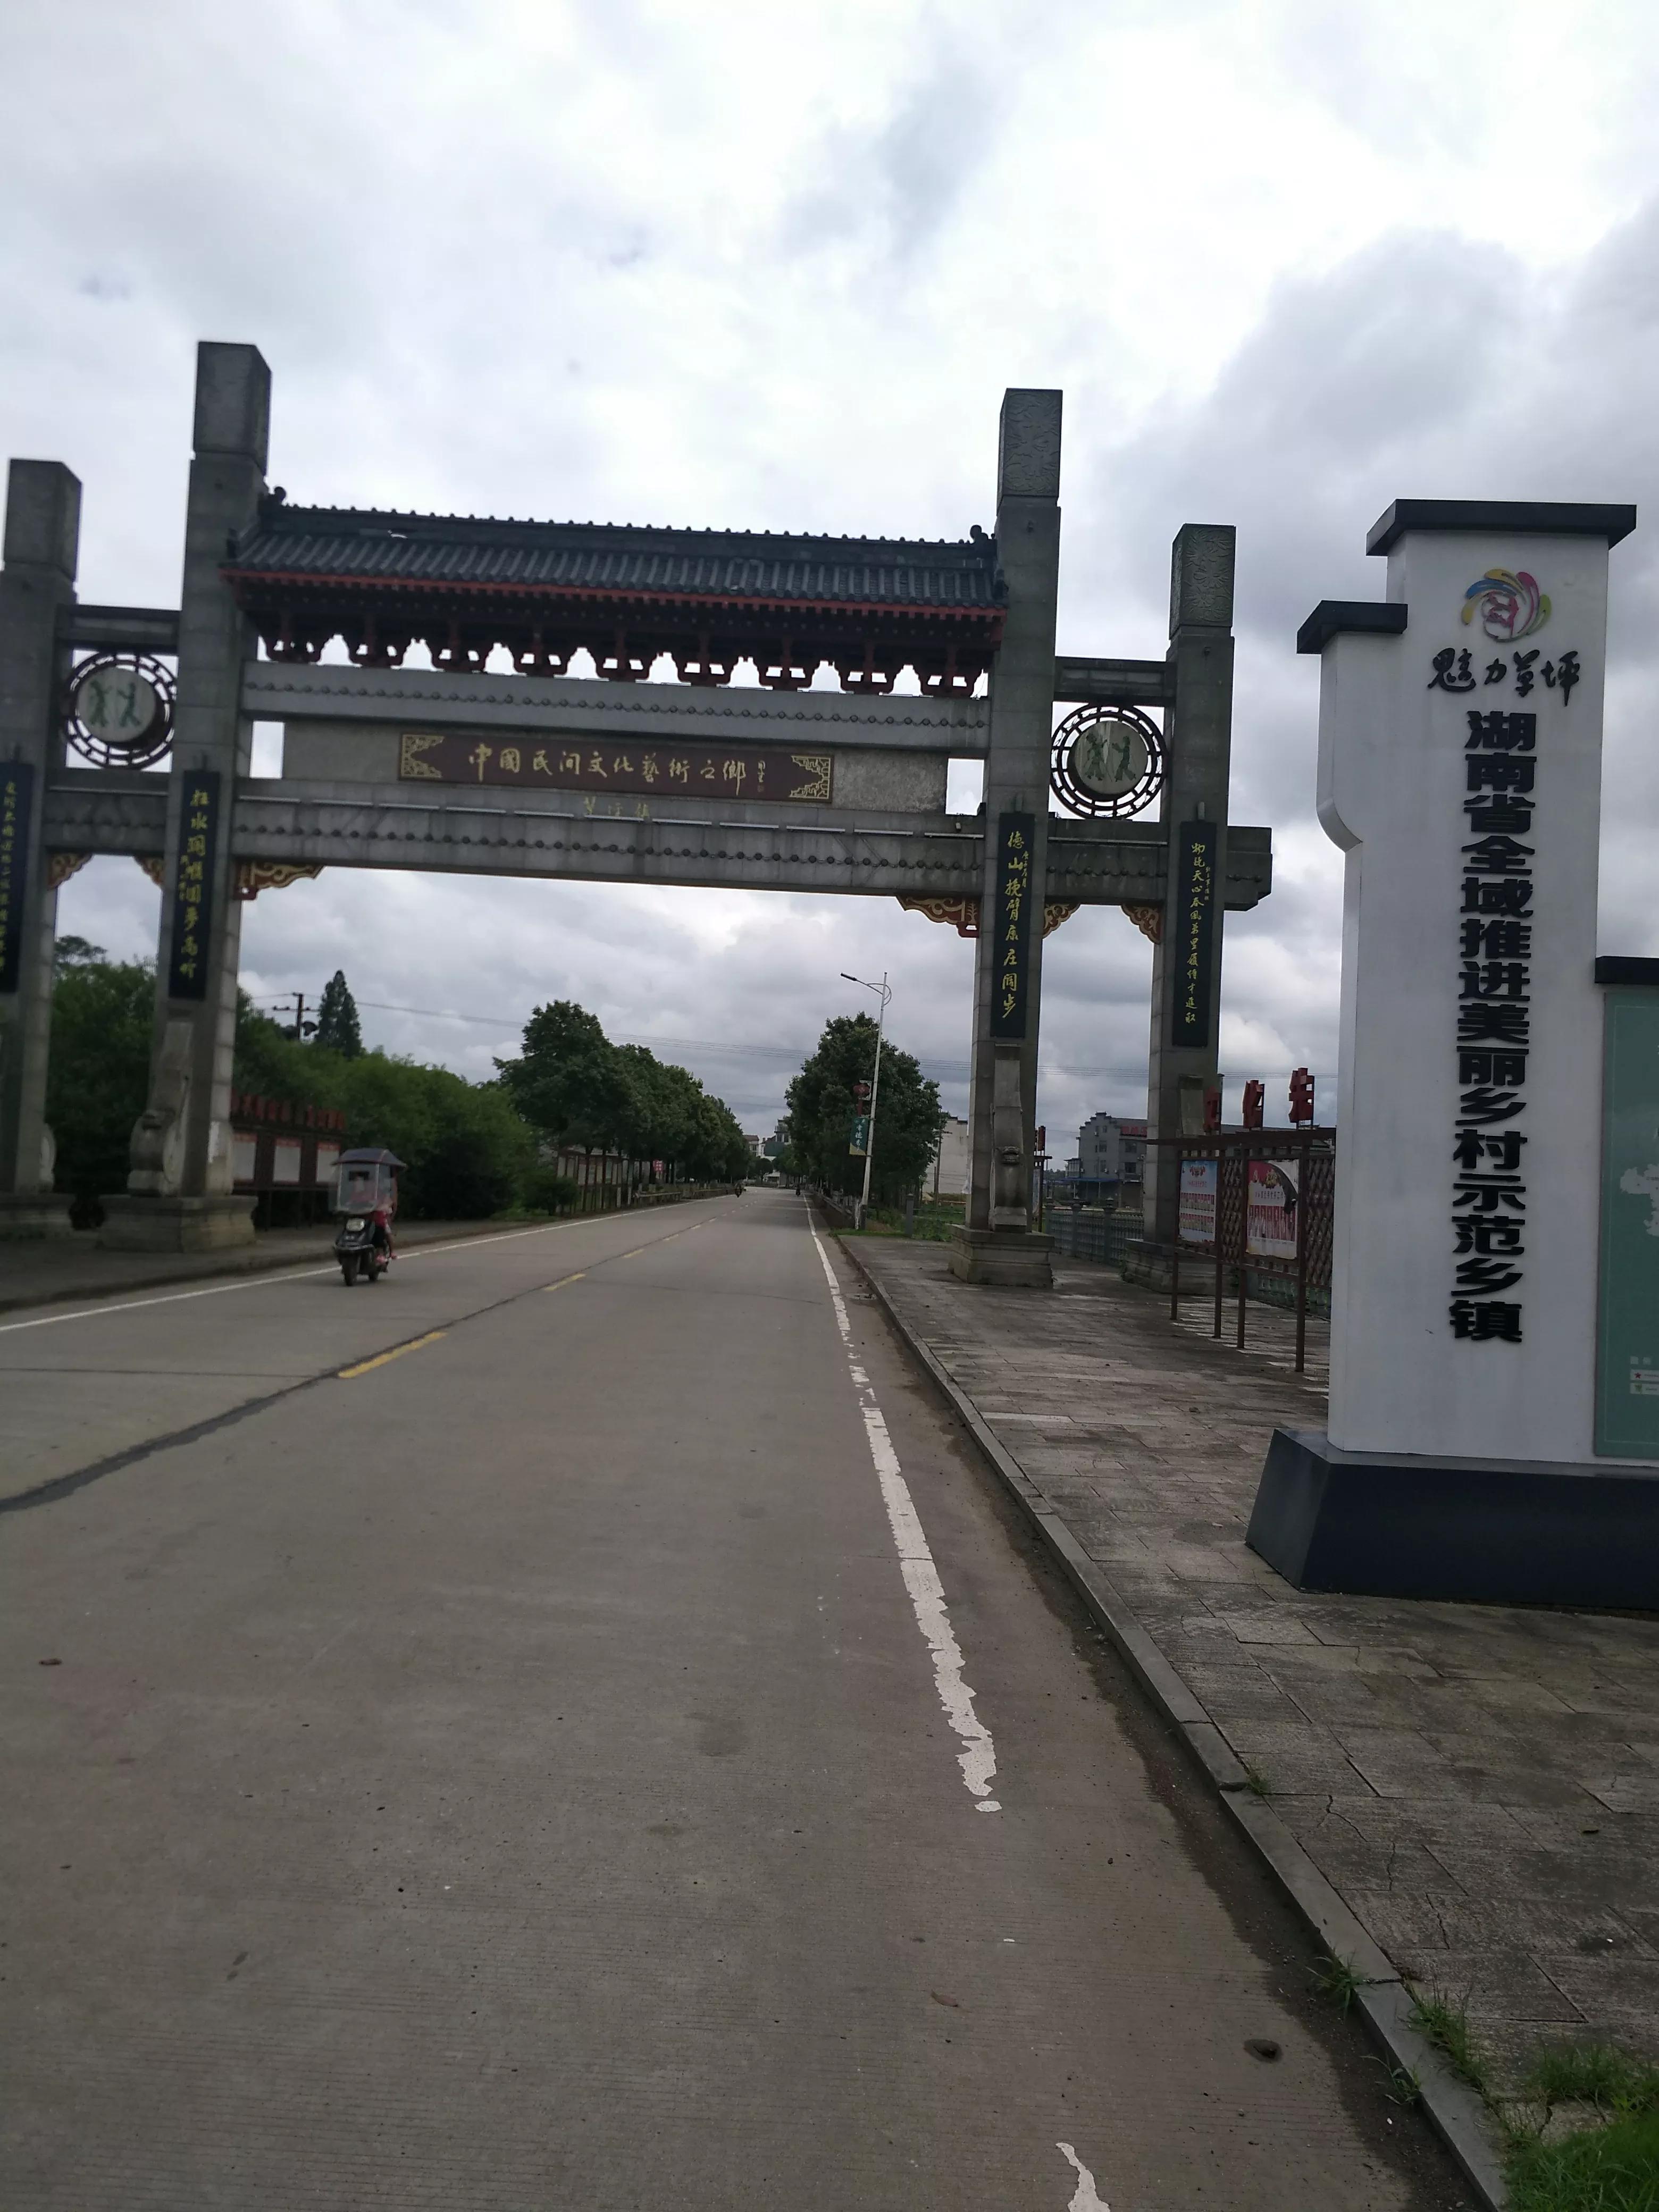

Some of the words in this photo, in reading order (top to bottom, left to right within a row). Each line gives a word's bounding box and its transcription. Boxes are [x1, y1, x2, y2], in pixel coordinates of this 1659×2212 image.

[1427, 647, 1580, 707] 魅力草坪
[1449, 710, 1537, 1343] 湖南省全域推进美丽乡村示范乡镇
